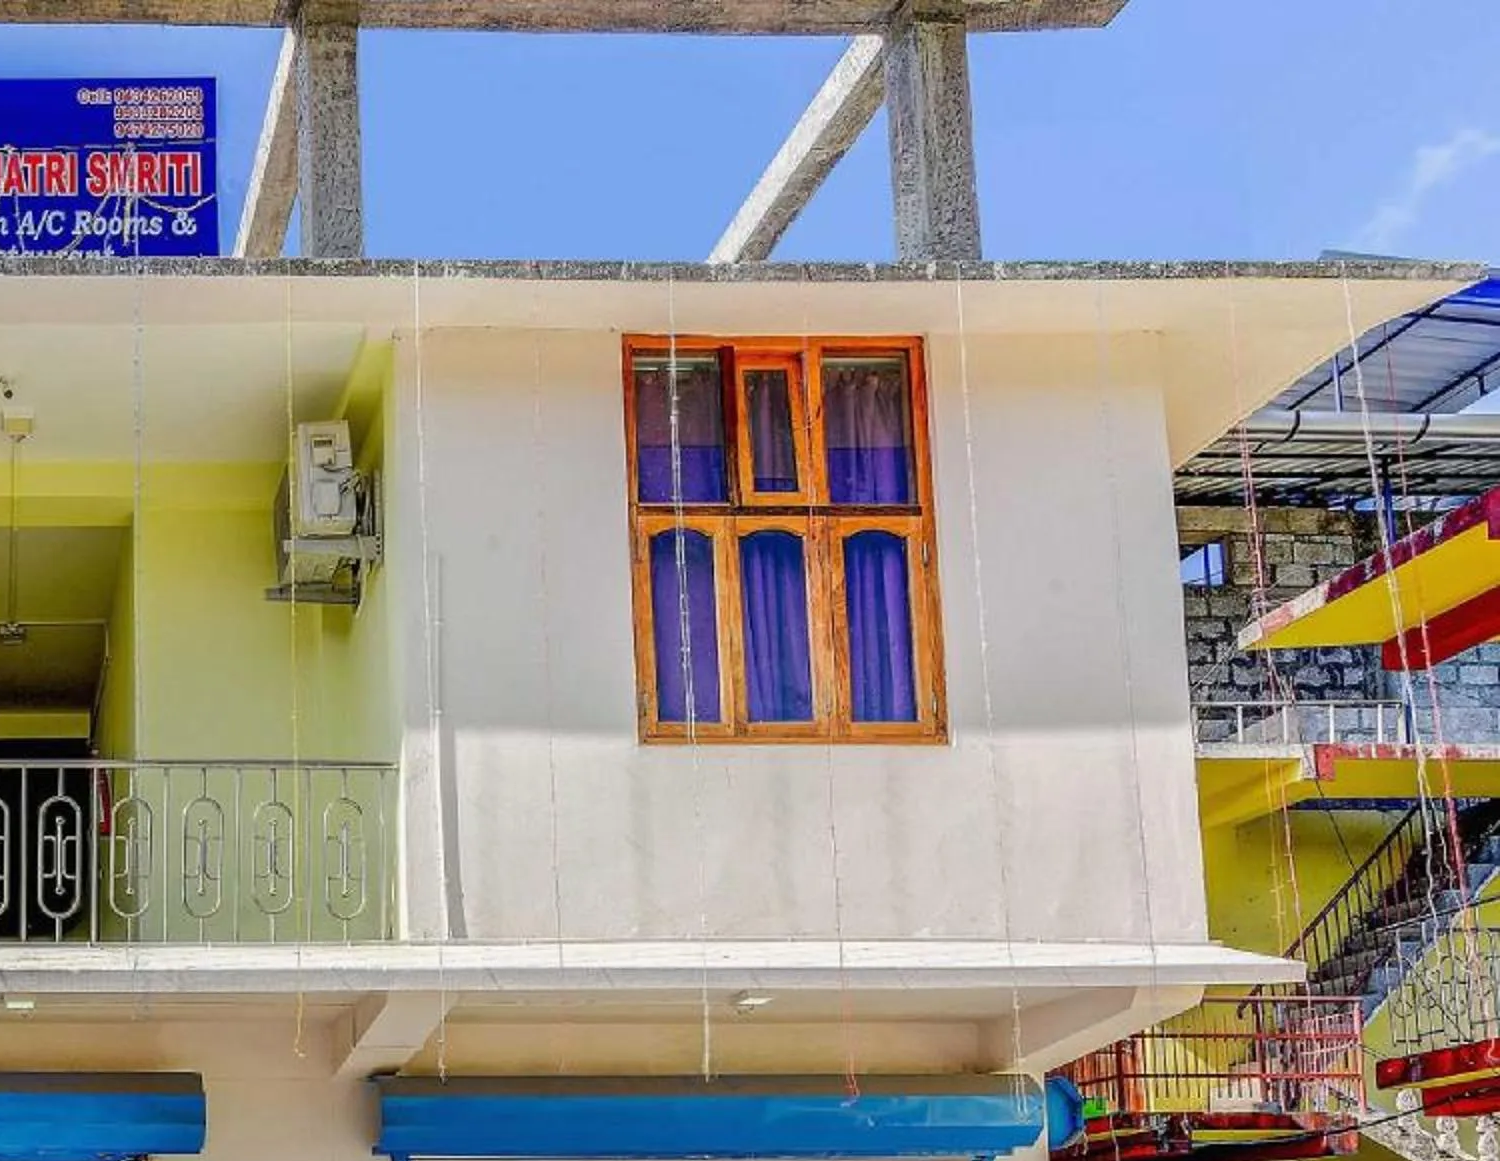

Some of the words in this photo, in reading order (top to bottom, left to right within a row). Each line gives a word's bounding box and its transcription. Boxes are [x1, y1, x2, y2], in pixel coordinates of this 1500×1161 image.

[86, 151, 201, 197] SMRITI
[16, 210, 66, 241] A/C
[71, 210, 163, 236] Rooms
[172, 210, 197, 236] &
